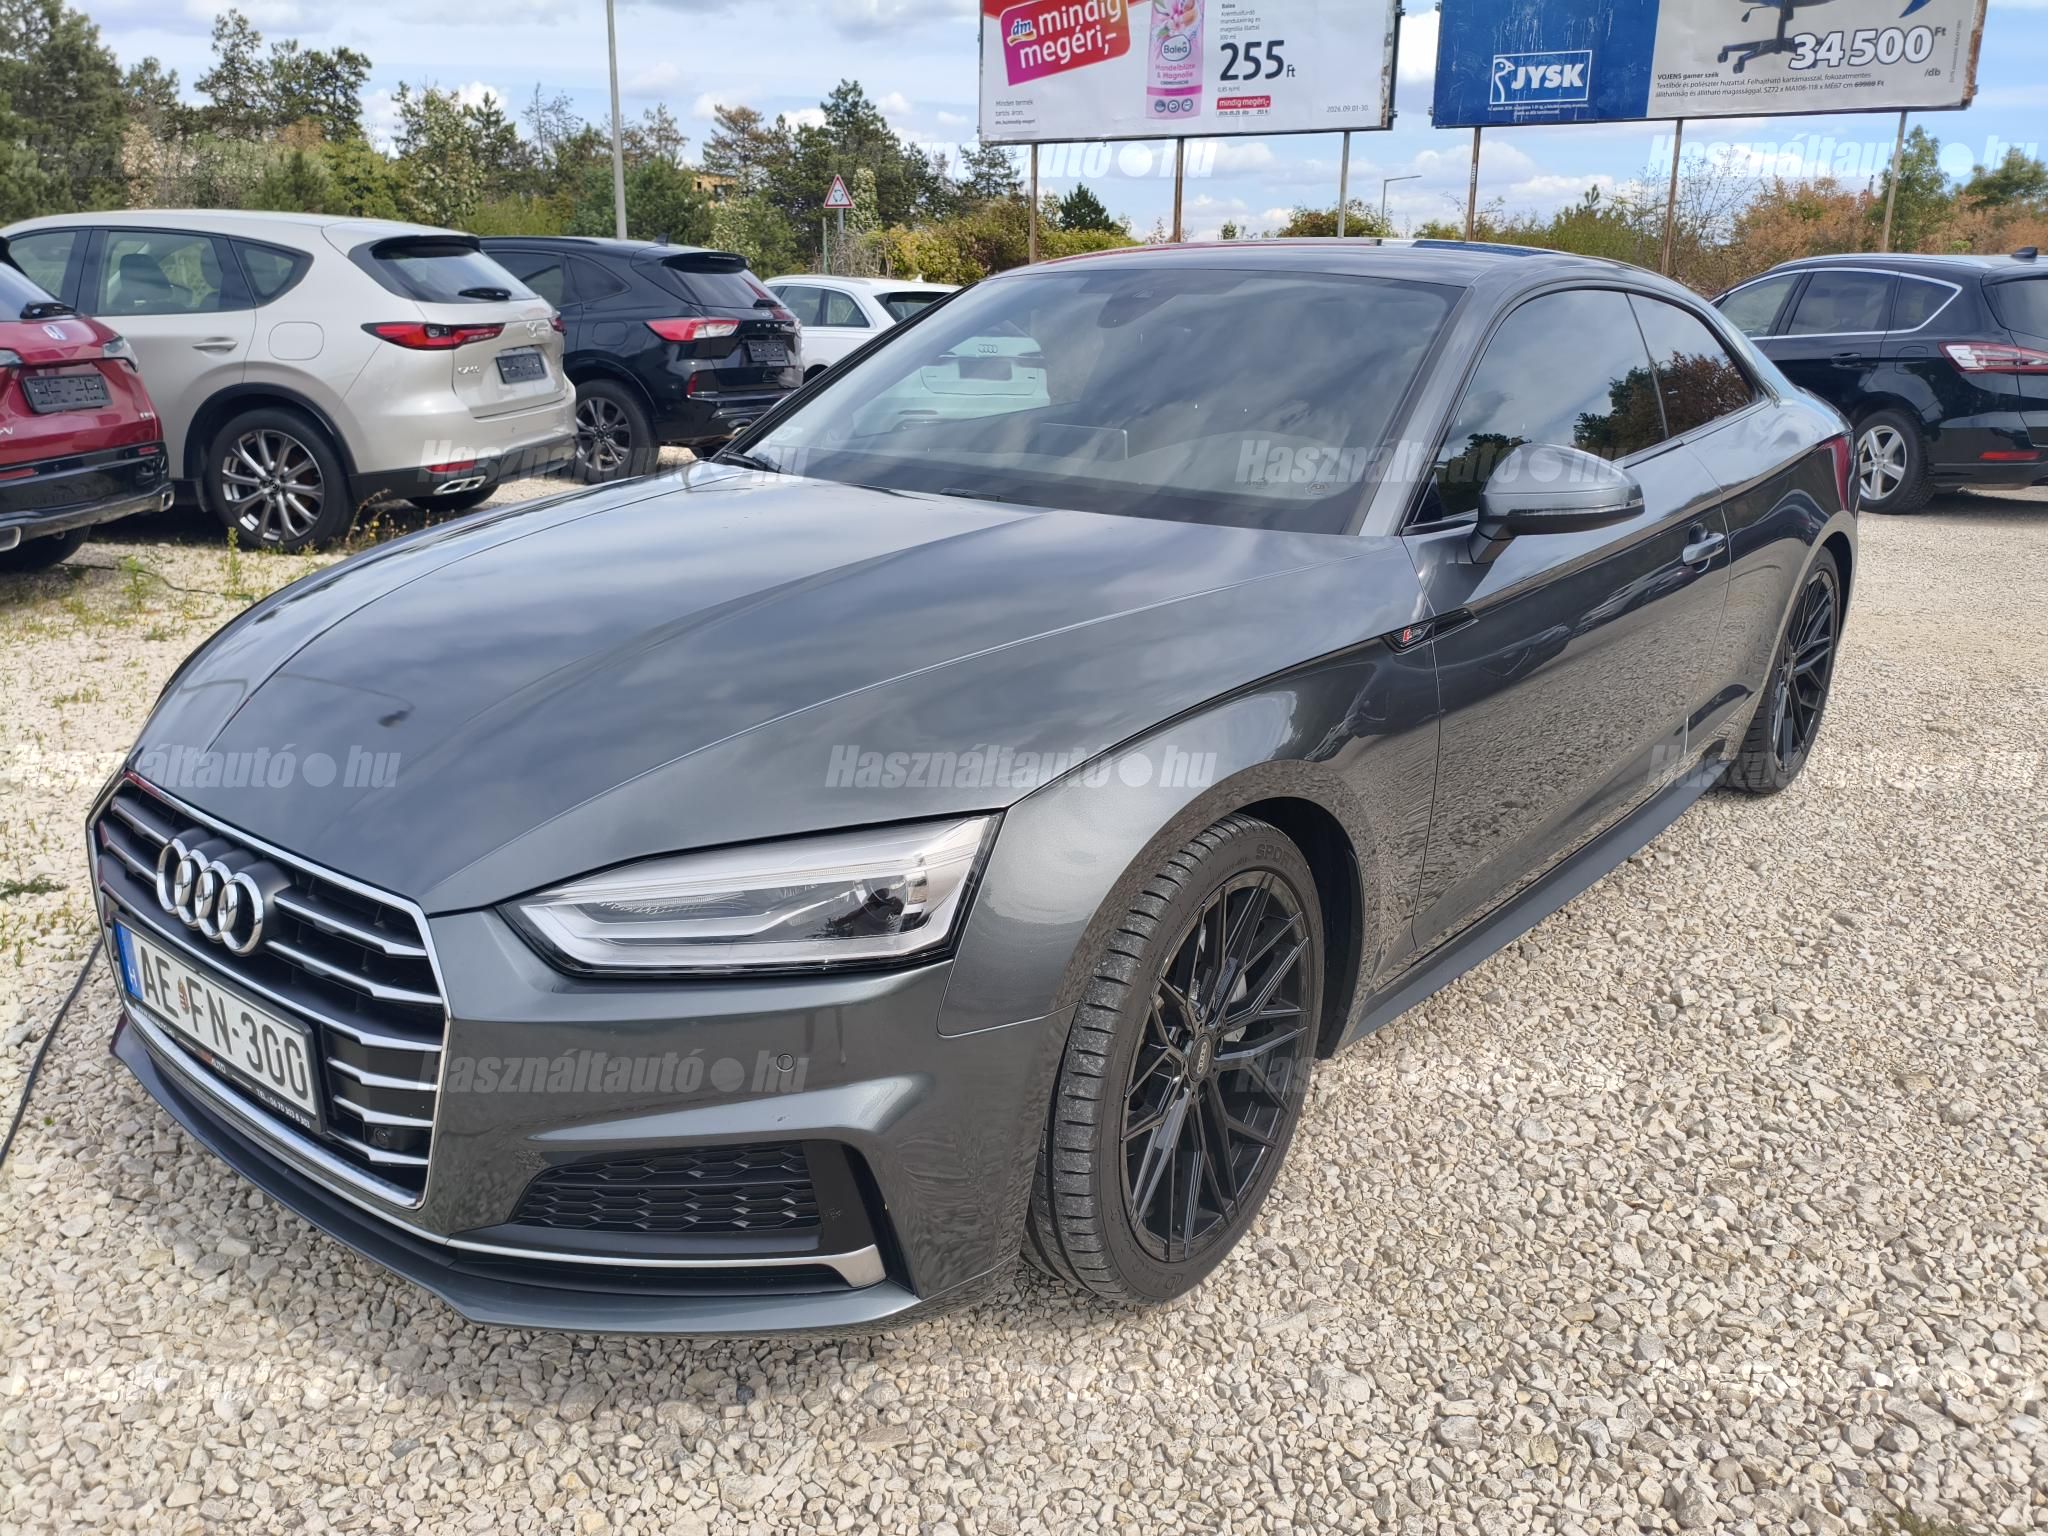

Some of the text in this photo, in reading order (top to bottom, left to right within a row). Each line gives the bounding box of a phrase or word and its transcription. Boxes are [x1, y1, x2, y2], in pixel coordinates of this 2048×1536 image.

[1038, 0, 1121, 36] mindig
[1012, 20, 1032, 36] dm
[1934, 26, 1946, 37] Ft
[1163, 42, 1188, 54] Balea
[1219, 40, 1296, 81] 255 Ft
[1511, 63, 1585, 90] JYSK
[1924, 67, 1941, 78] /db
[1219, 98, 1241, 108] mindig
[140, 946, 179, 1019] AE
